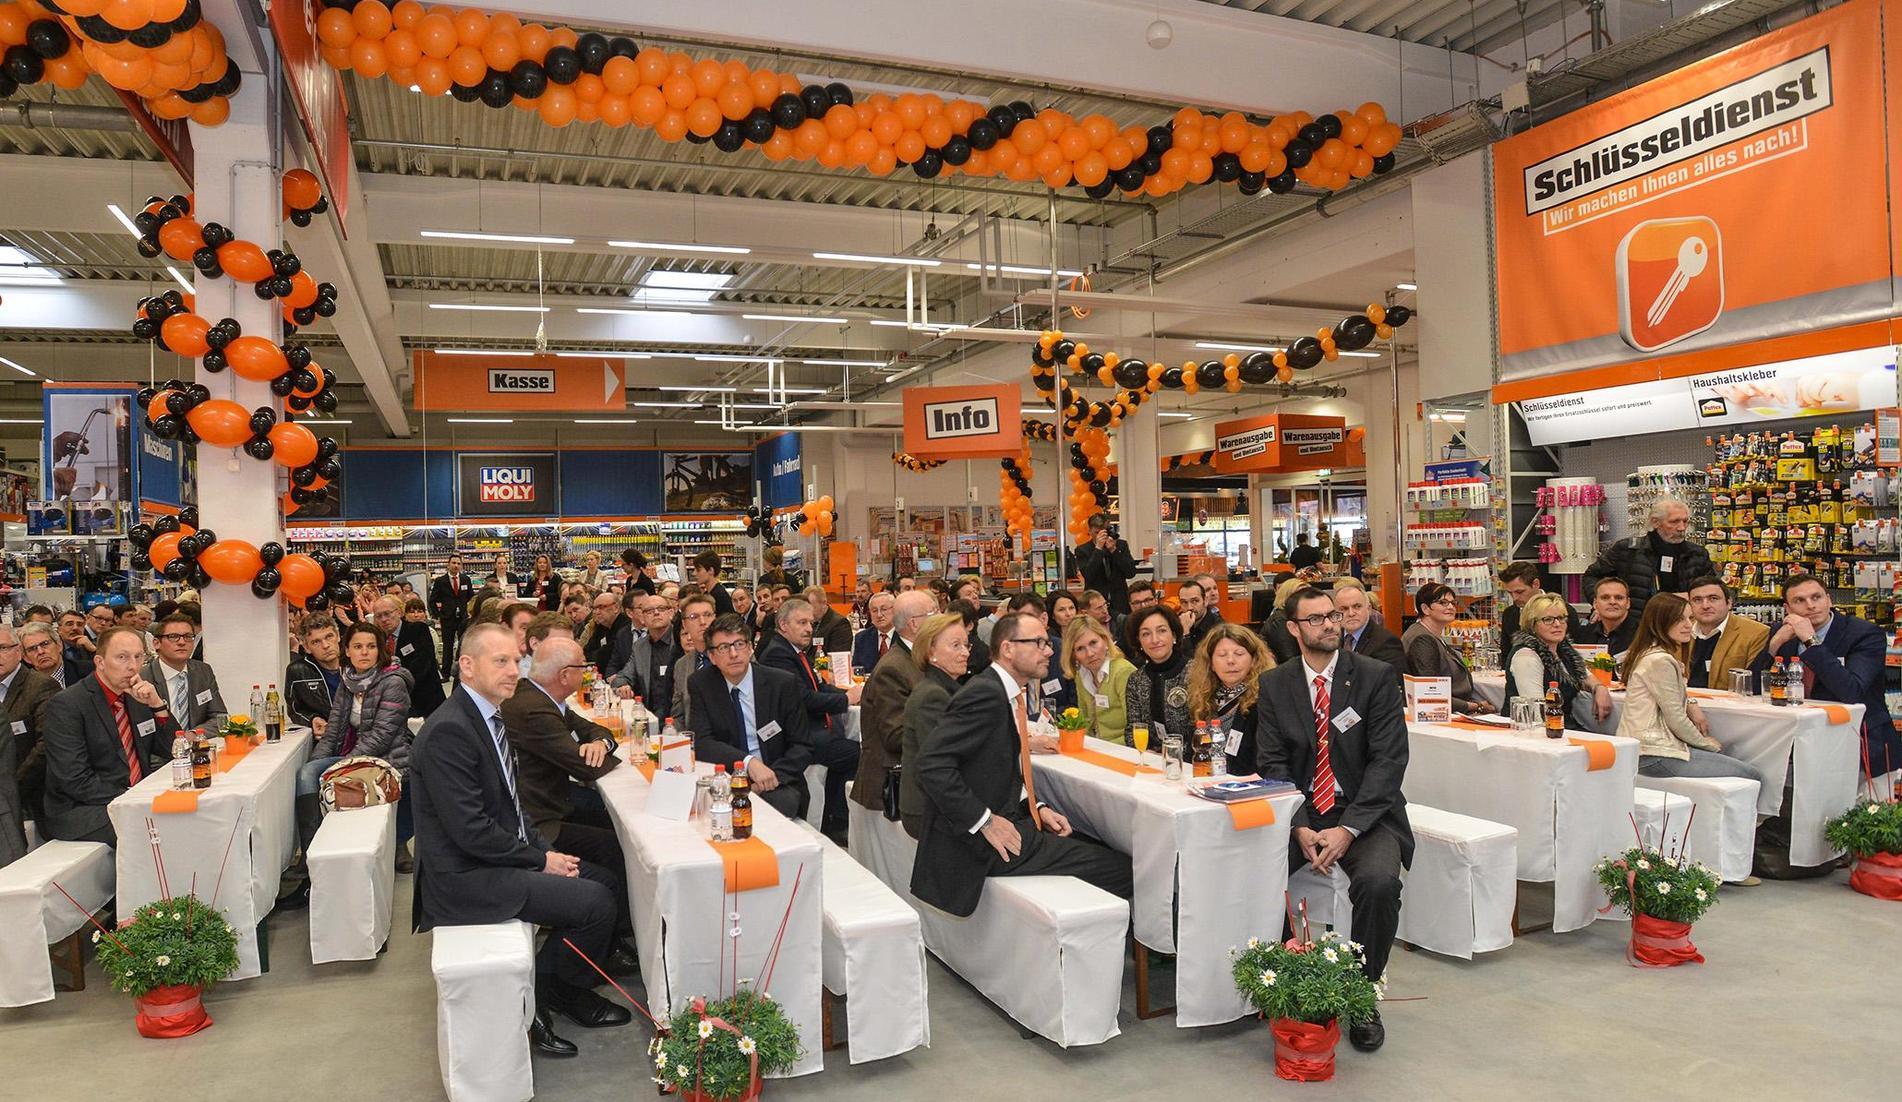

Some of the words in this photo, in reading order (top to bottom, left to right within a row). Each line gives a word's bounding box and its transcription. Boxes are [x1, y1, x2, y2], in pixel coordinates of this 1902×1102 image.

[1534, 67, 1818, 201] Schlüsseldienst
[1550, 206, 1574, 226] Wir
[1578, 186, 1637, 216] machen
[1643, 168, 1688, 195] Ihnen
[1694, 149, 1737, 175] alles
[1744, 125, 1798, 159] nach!
[494, 373, 549, 389] Kasse
[1693, 370, 1777, 388] Haushaltskleber
[1524, 397, 1584, 412] Schlüsseldienst
[933, 405, 990, 432] Info
[1219, 430, 1273, 450] Warenausgabe
[1284, 431, 1341, 442] Warenausgabe
[483, 468, 532, 484] LIQUI
[483, 485, 533, 500] MOLY
